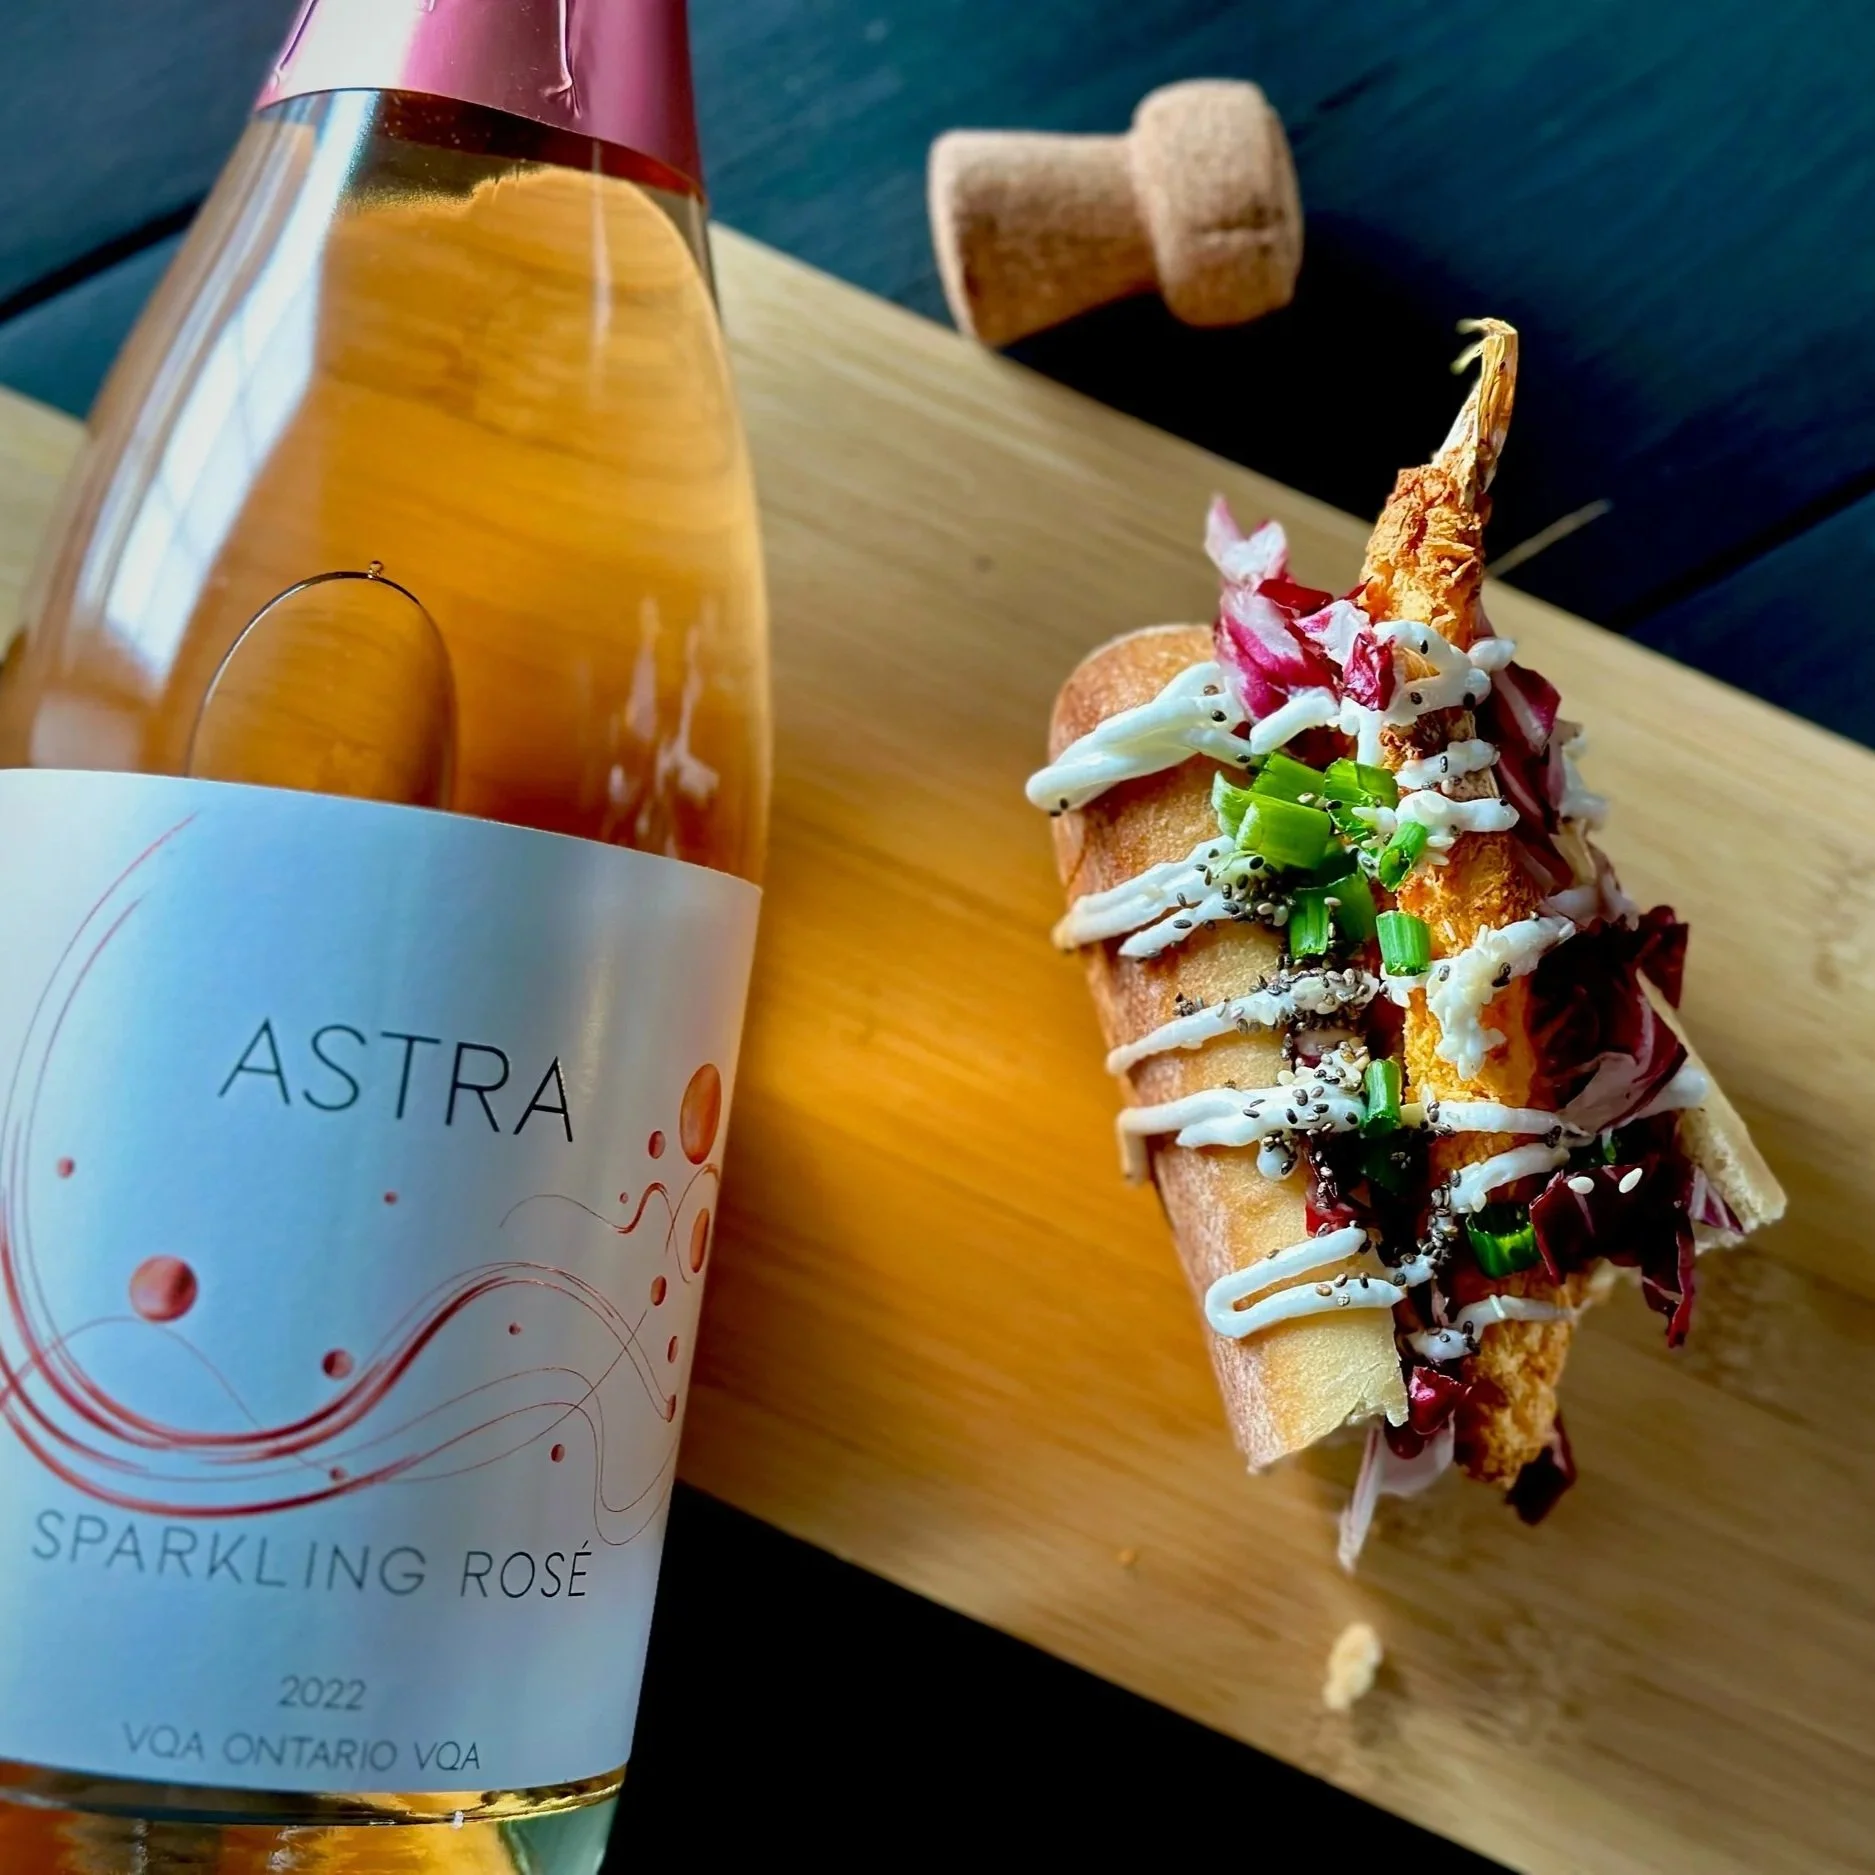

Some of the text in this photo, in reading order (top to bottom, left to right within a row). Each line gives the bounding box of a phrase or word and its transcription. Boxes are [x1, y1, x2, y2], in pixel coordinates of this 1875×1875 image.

[219, 1017, 574, 1143] ASTRA
[30, 1508, 592, 1599] SPARKLING ROSÉ
[279, 1675, 368, 1712] 2022
[121, 1721, 480, 1773] VQA ONTARIO VQA
